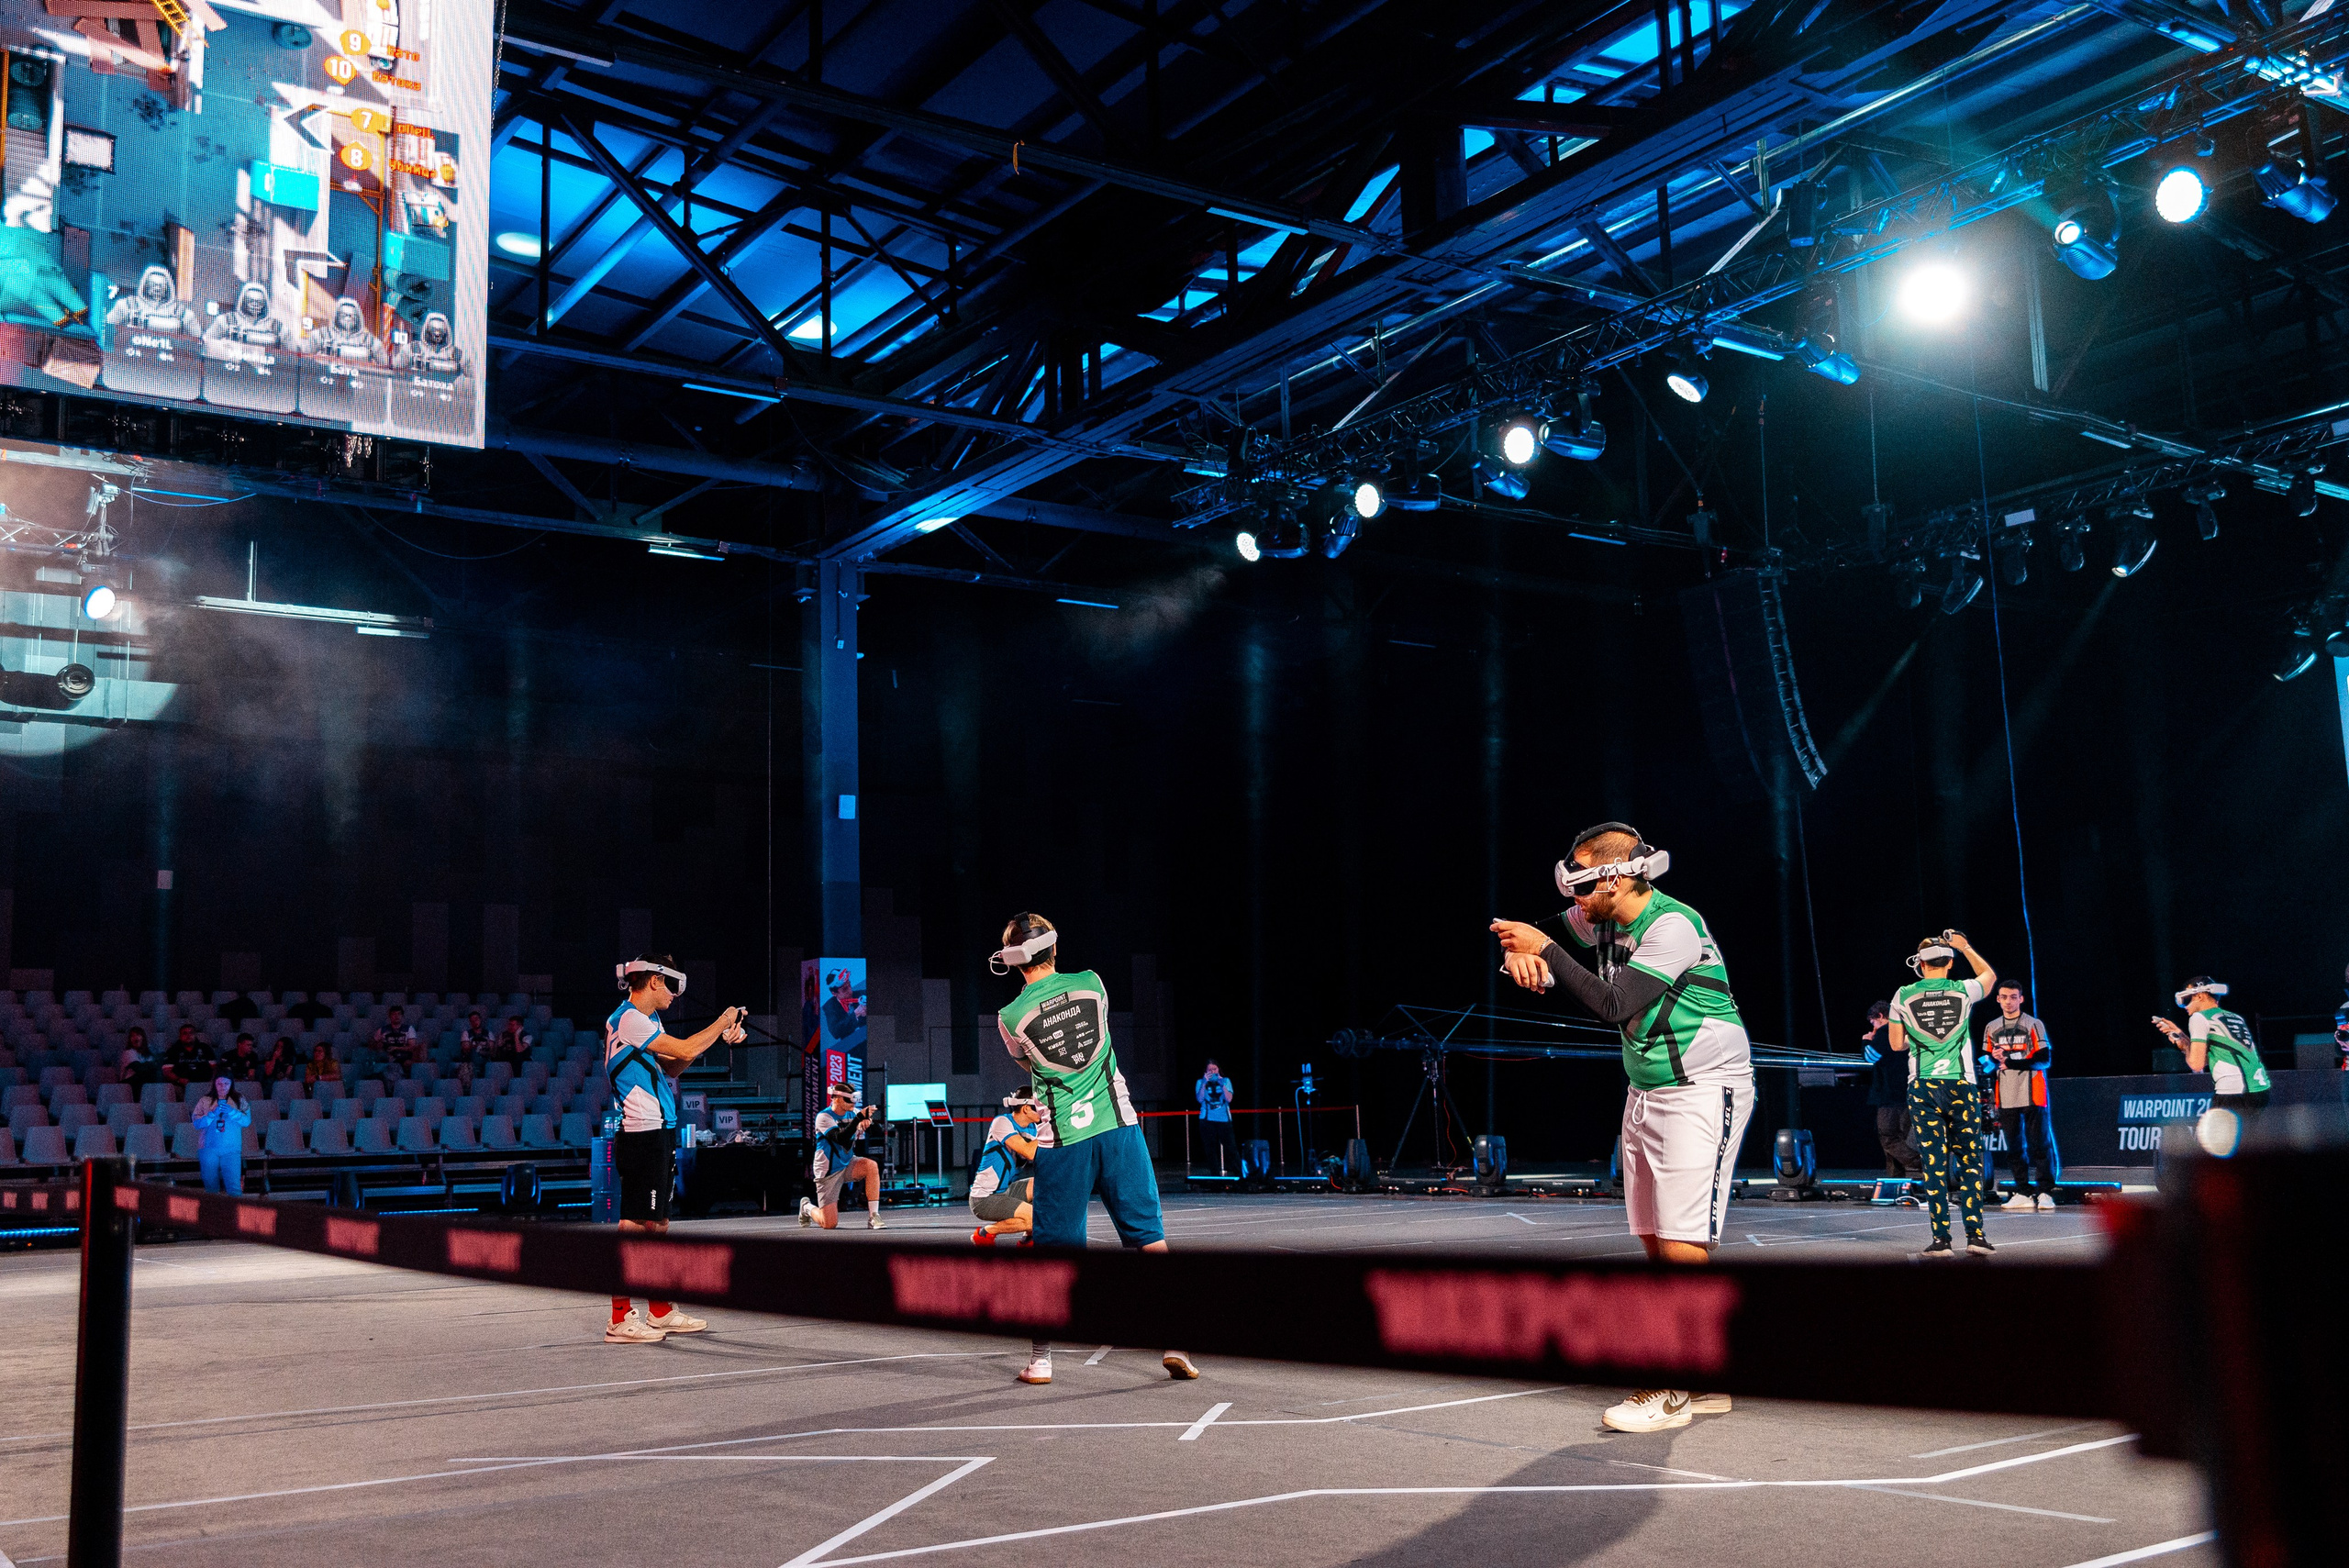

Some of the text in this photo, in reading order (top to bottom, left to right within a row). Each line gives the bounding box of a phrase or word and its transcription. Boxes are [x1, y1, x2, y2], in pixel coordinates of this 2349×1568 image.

[350, 33, 362, 52] 9
[330, 59, 351, 79] 10
[362, 111, 373, 129] 7
[351, 149, 362, 167] 8
[1041, 994, 1066, 1008] WARPOINT
[1042, 1006, 1081, 1029] АНАКОНДА
[829, 1055, 842, 1083] 2023
[1931, 1059, 1951, 1076] 2
[2254, 1068, 2266, 1085] 4
[1070, 1088, 1095, 1129] 5
[2124, 1098, 2194, 1118] WARPOINT
